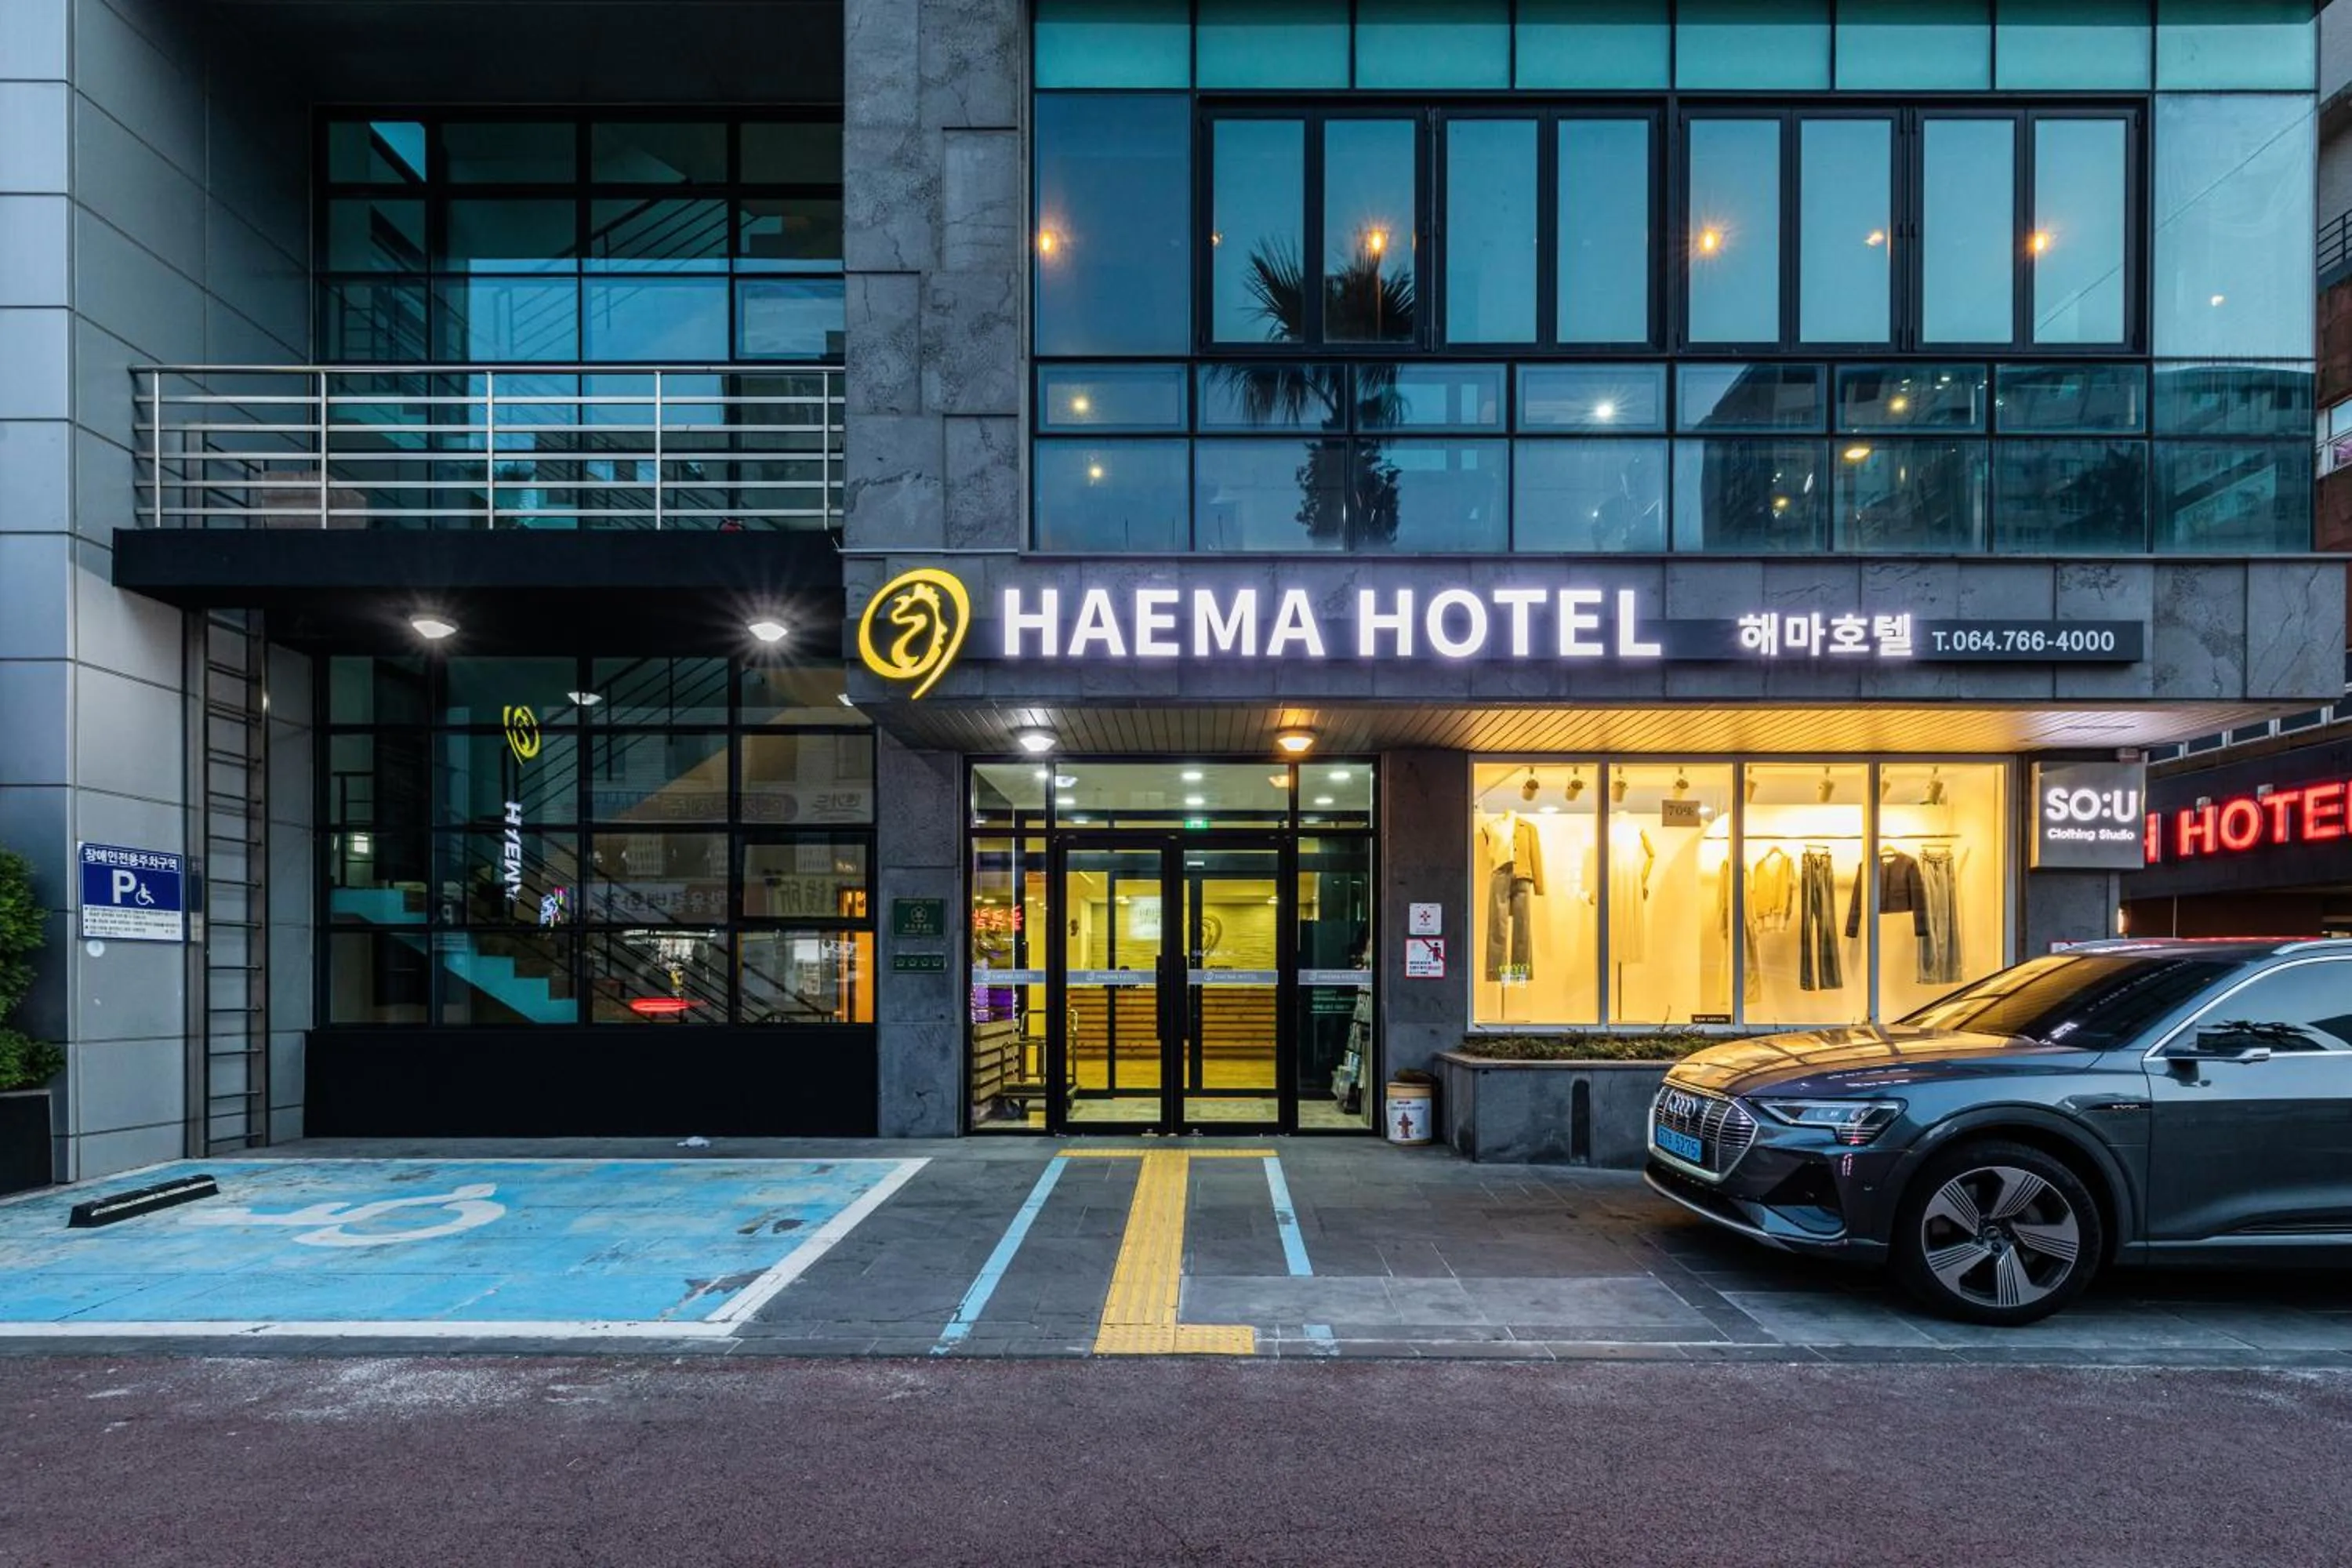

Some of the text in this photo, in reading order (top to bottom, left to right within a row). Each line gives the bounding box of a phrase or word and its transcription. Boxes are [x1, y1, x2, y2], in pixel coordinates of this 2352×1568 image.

[1004, 589, 1661, 658] HAEMA HOTEL
[1738, 613, 1912, 656] 해마호텔
[1932, 630, 2114, 652] T.064.766-4000
[2045, 788, 2138, 822] SO:U
[2179, 781, 2352, 856] HOTE
[2047, 828, 2135, 841] Clothing Studio
[84, 848, 177, 872] 장애인전용주차구역
[112, 869, 136, 904] P
